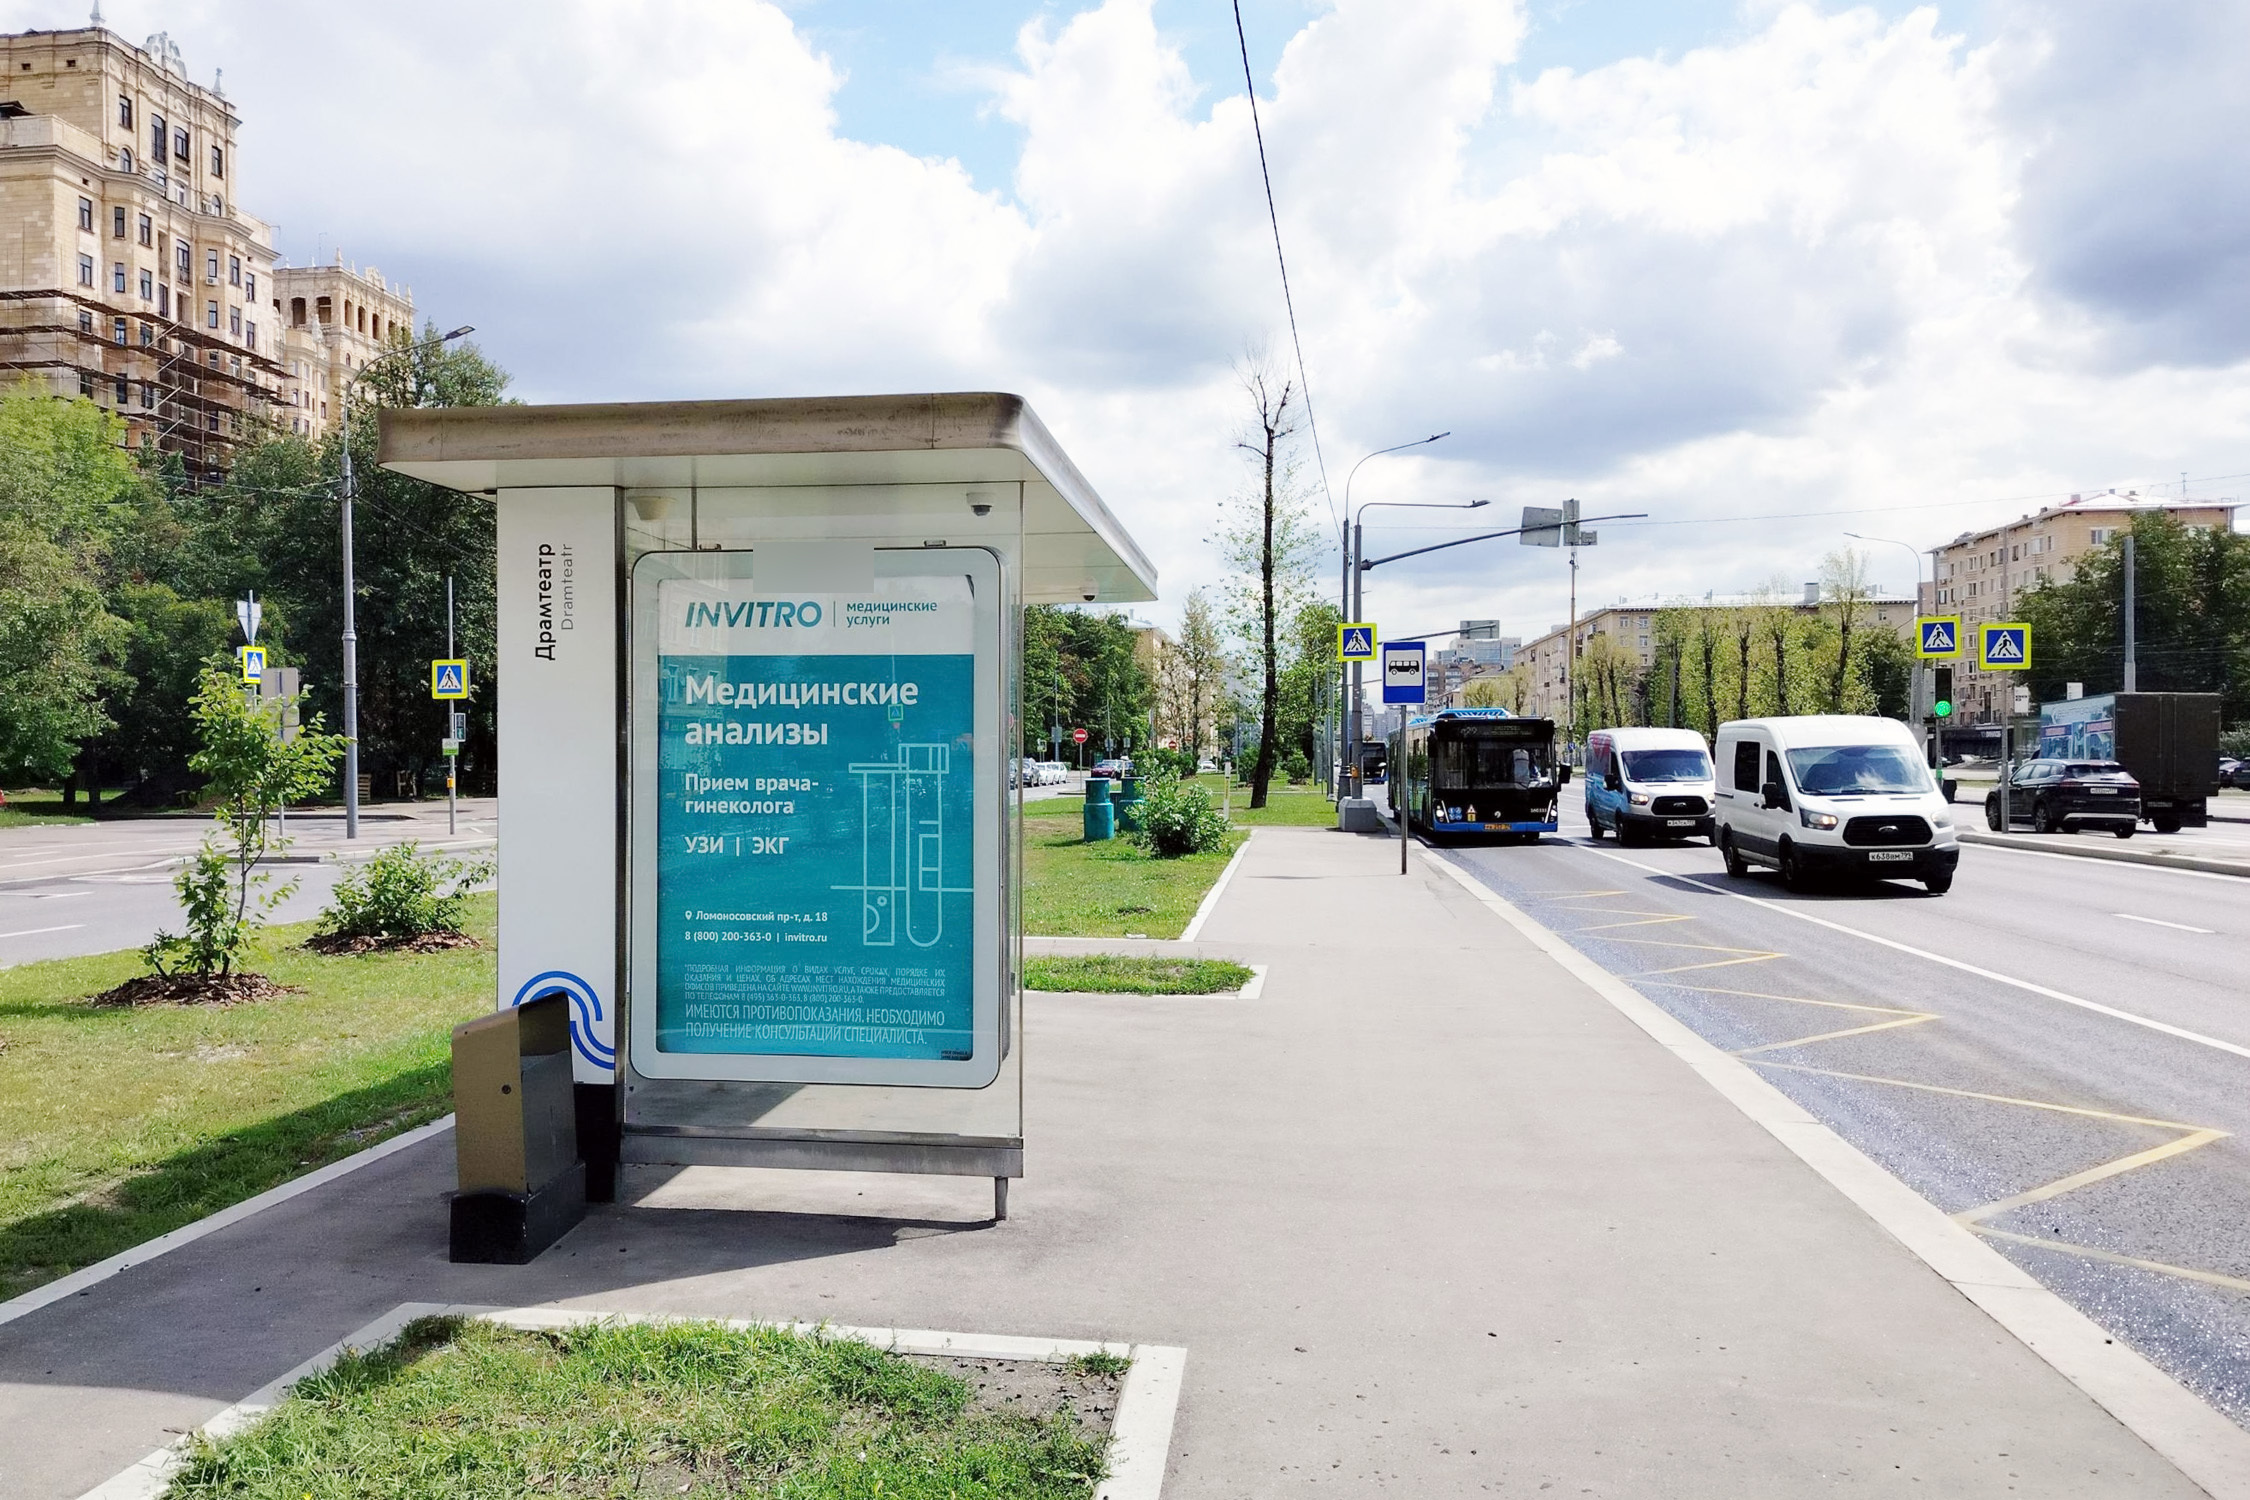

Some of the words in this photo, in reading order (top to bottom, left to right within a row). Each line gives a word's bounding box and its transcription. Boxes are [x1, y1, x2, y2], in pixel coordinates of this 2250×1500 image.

[561, 544, 573, 630] Dramteatr
[535, 543, 556, 661] Драмтеатр
[846, 601, 938, 613] медицинские
[685, 601, 822, 628] INVITRO
[846, 614, 890, 626] услуги
[685, 675, 919, 709] Медицинские
[684, 722, 828, 746] анализы
[685, 773, 748, 794] Прием
[755, 775, 819, 795] врача-
[685, 800, 794, 815] гинеколога
[684, 836, 724, 854] УЗИ
[752, 837, 789, 854] ЭКГ
[696, 910, 775, 921] Ломоносовский
[777, 912, 801, 923] пр-т,
[803, 913, 813, 922] д.
[815, 912, 828, 922] 18
[684, 931, 691, 941] 8
[693, 931, 719, 942] (800)
[721, 931, 772, 942] 200-363-0
[784, 932, 828, 942] invitro.ru
[736, 965, 786, 974] ИНФОРМАЦИЯ
[685, 1003, 740, 1019] ИМЕЮТСЯ
[743, 1005, 864, 1023] ПРОТИВОПОКАЗАНИЯ.
[866, 1008, 945, 1027] НЕОБХОДИМО
[685, 1022, 752, 1039] ПОЛУЧЕНИЕ
[755, 1024, 841, 1043] КОНСУЛЬТАЦИИ
[844, 1026, 928, 1045] СПЕЦИАЛИСТА.
